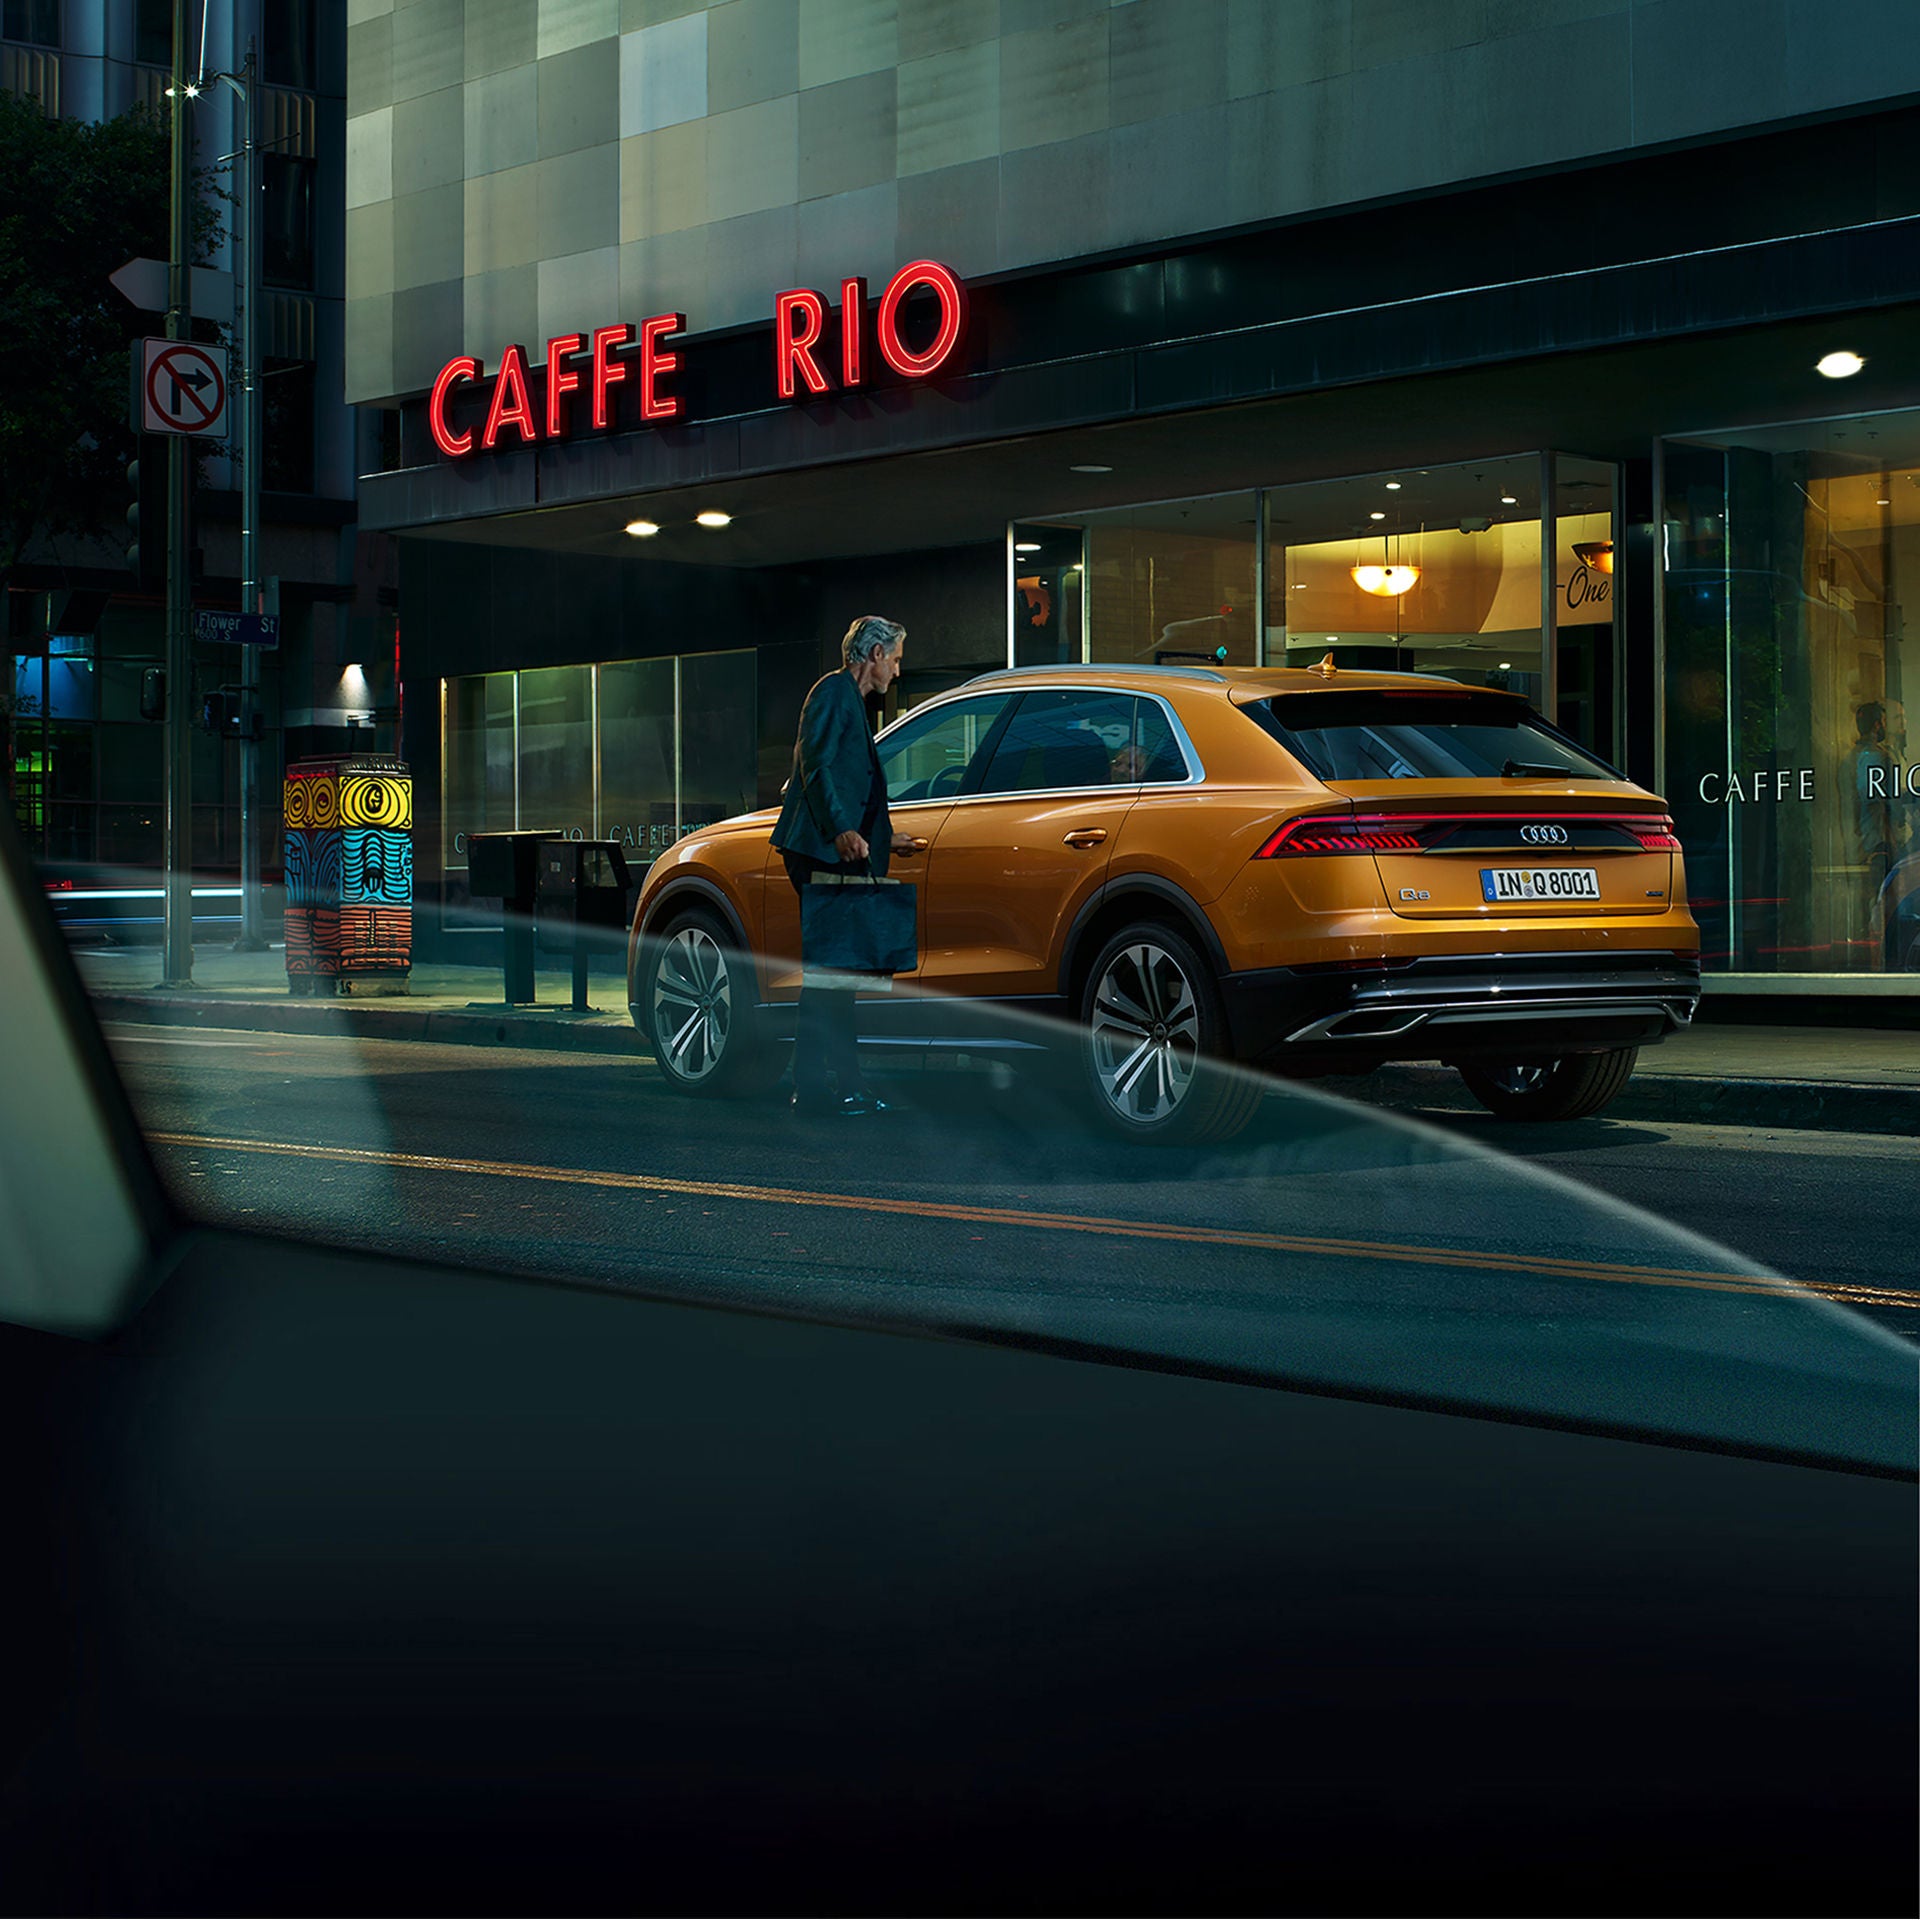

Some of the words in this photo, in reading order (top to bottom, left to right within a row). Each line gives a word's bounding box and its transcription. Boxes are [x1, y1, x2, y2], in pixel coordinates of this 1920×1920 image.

[429, 312, 685, 458] CAFFE
[775, 259, 968, 398] RIO
[199, 612, 241, 631] Flower
[260, 616, 275, 634] St
[1699, 769, 1815, 804] CAFFE
[1399, 888, 1430, 900] Q8
[1498, 872, 1522, 896] IN
